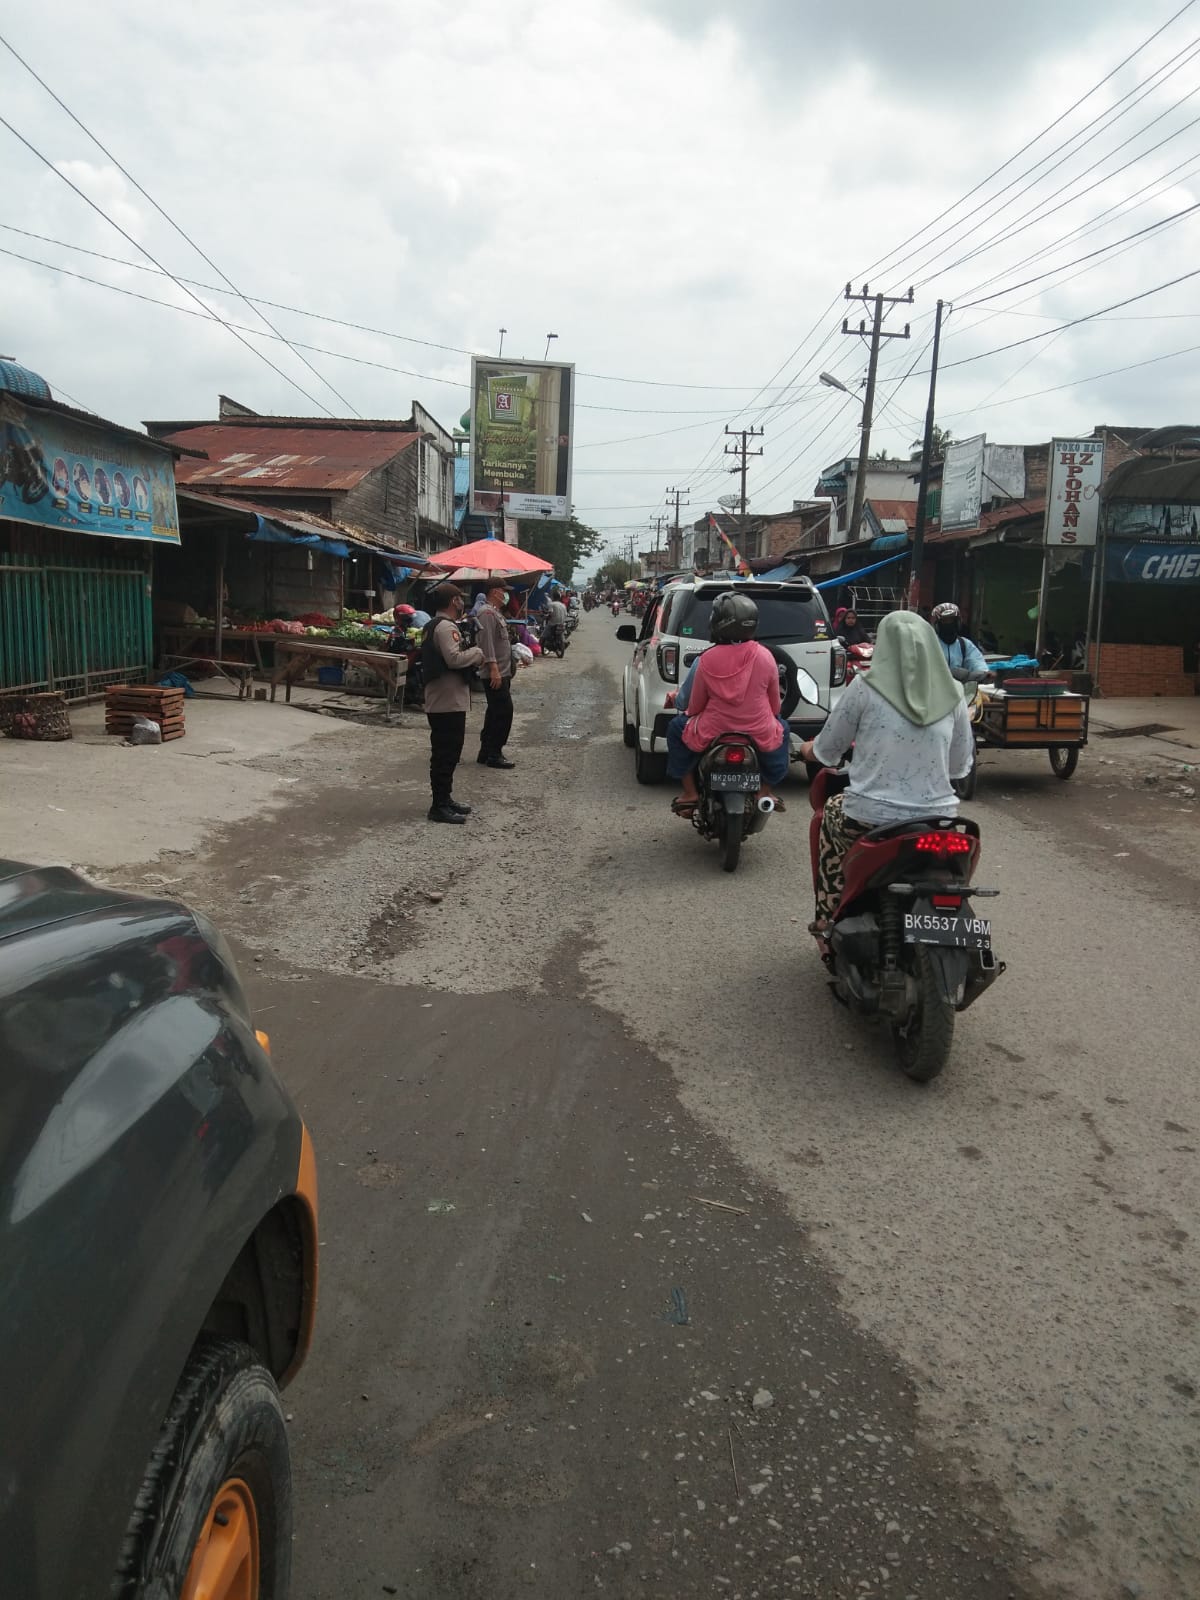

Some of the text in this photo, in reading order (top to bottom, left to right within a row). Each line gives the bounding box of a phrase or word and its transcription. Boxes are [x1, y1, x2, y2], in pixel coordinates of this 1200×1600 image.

[1056, 443, 1080, 452] TOKO
[482, 460, 527, 470] Tarikannya
[483, 469, 525, 479] Membuka
[964, 918, 991, 935] VBM
[955, 937, 990, 949] 11 23
